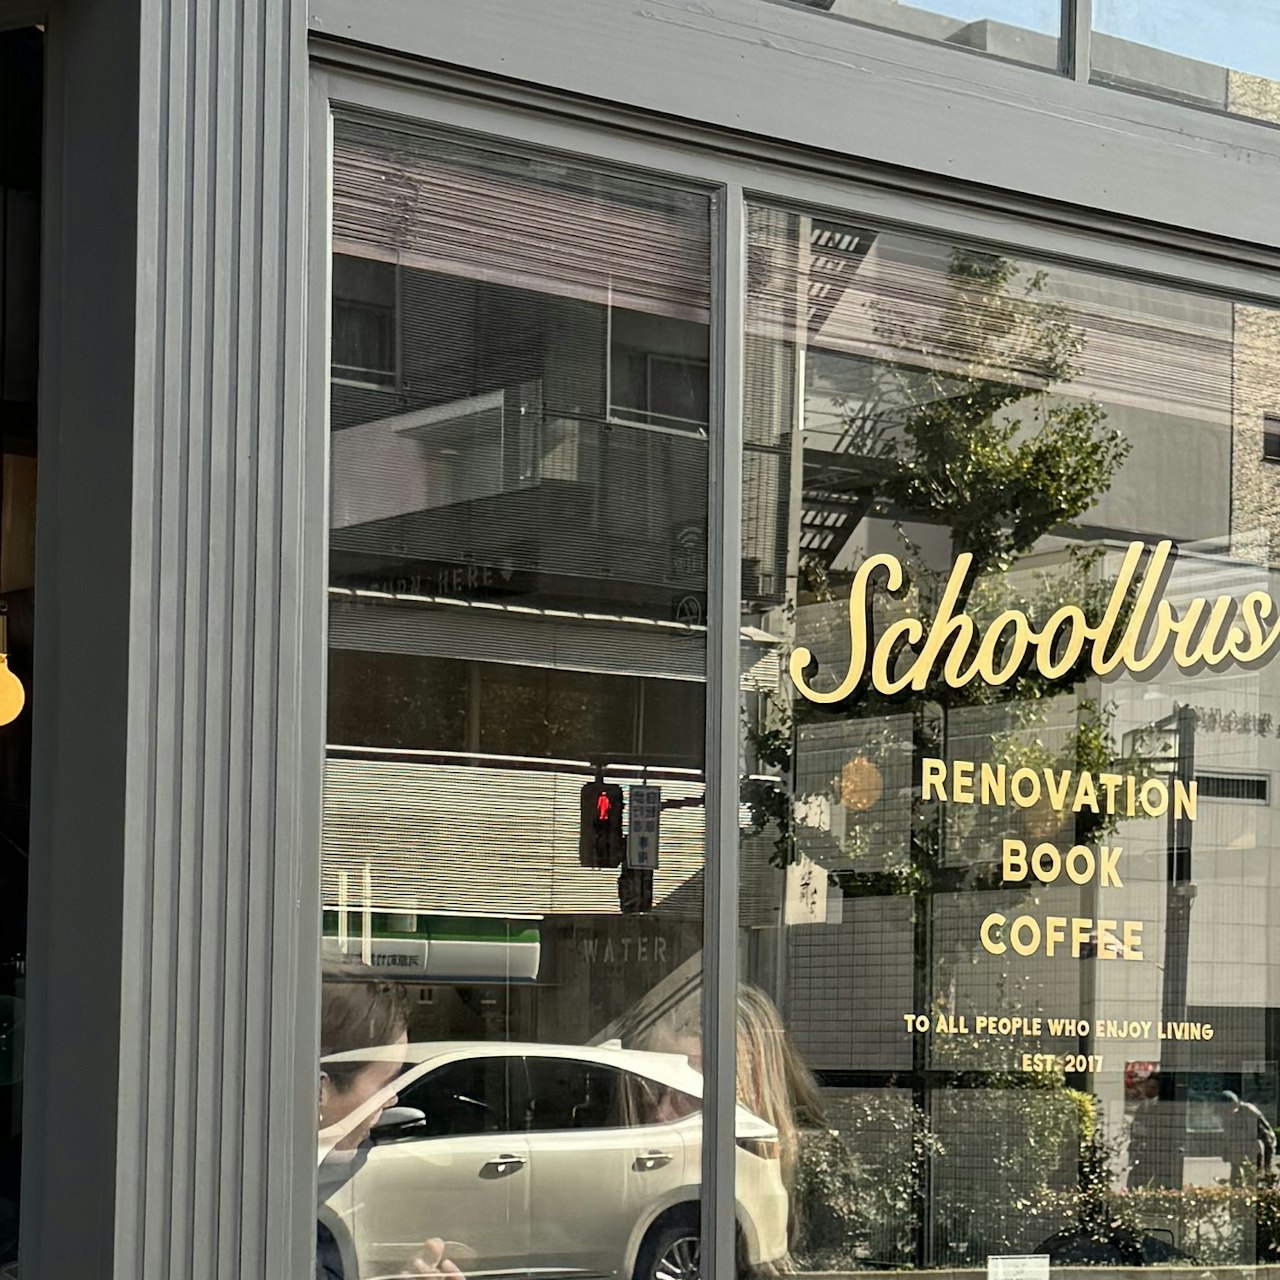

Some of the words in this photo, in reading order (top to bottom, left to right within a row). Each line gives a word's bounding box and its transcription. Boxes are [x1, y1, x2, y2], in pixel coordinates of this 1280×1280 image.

[920, 757, 1198, 821] RENOVATION
[1002, 839, 1123, 888] BOOK
[582, 935, 668, 963] WATER
[979, 912, 1144, 961] COFFEE
[903, 1014, 930, 1033] TO
[935, 1015, 969, 1034] ALL
[975, 1016, 1042, 1036] PEOPLE
[1047, 1019, 1090, 1037] WHO
[1095, 1020, 1153, 1039] ENJOY
[1157, 1022, 1215, 1041] LIVING
[1064, 1054, 1104, 1073] 2017
